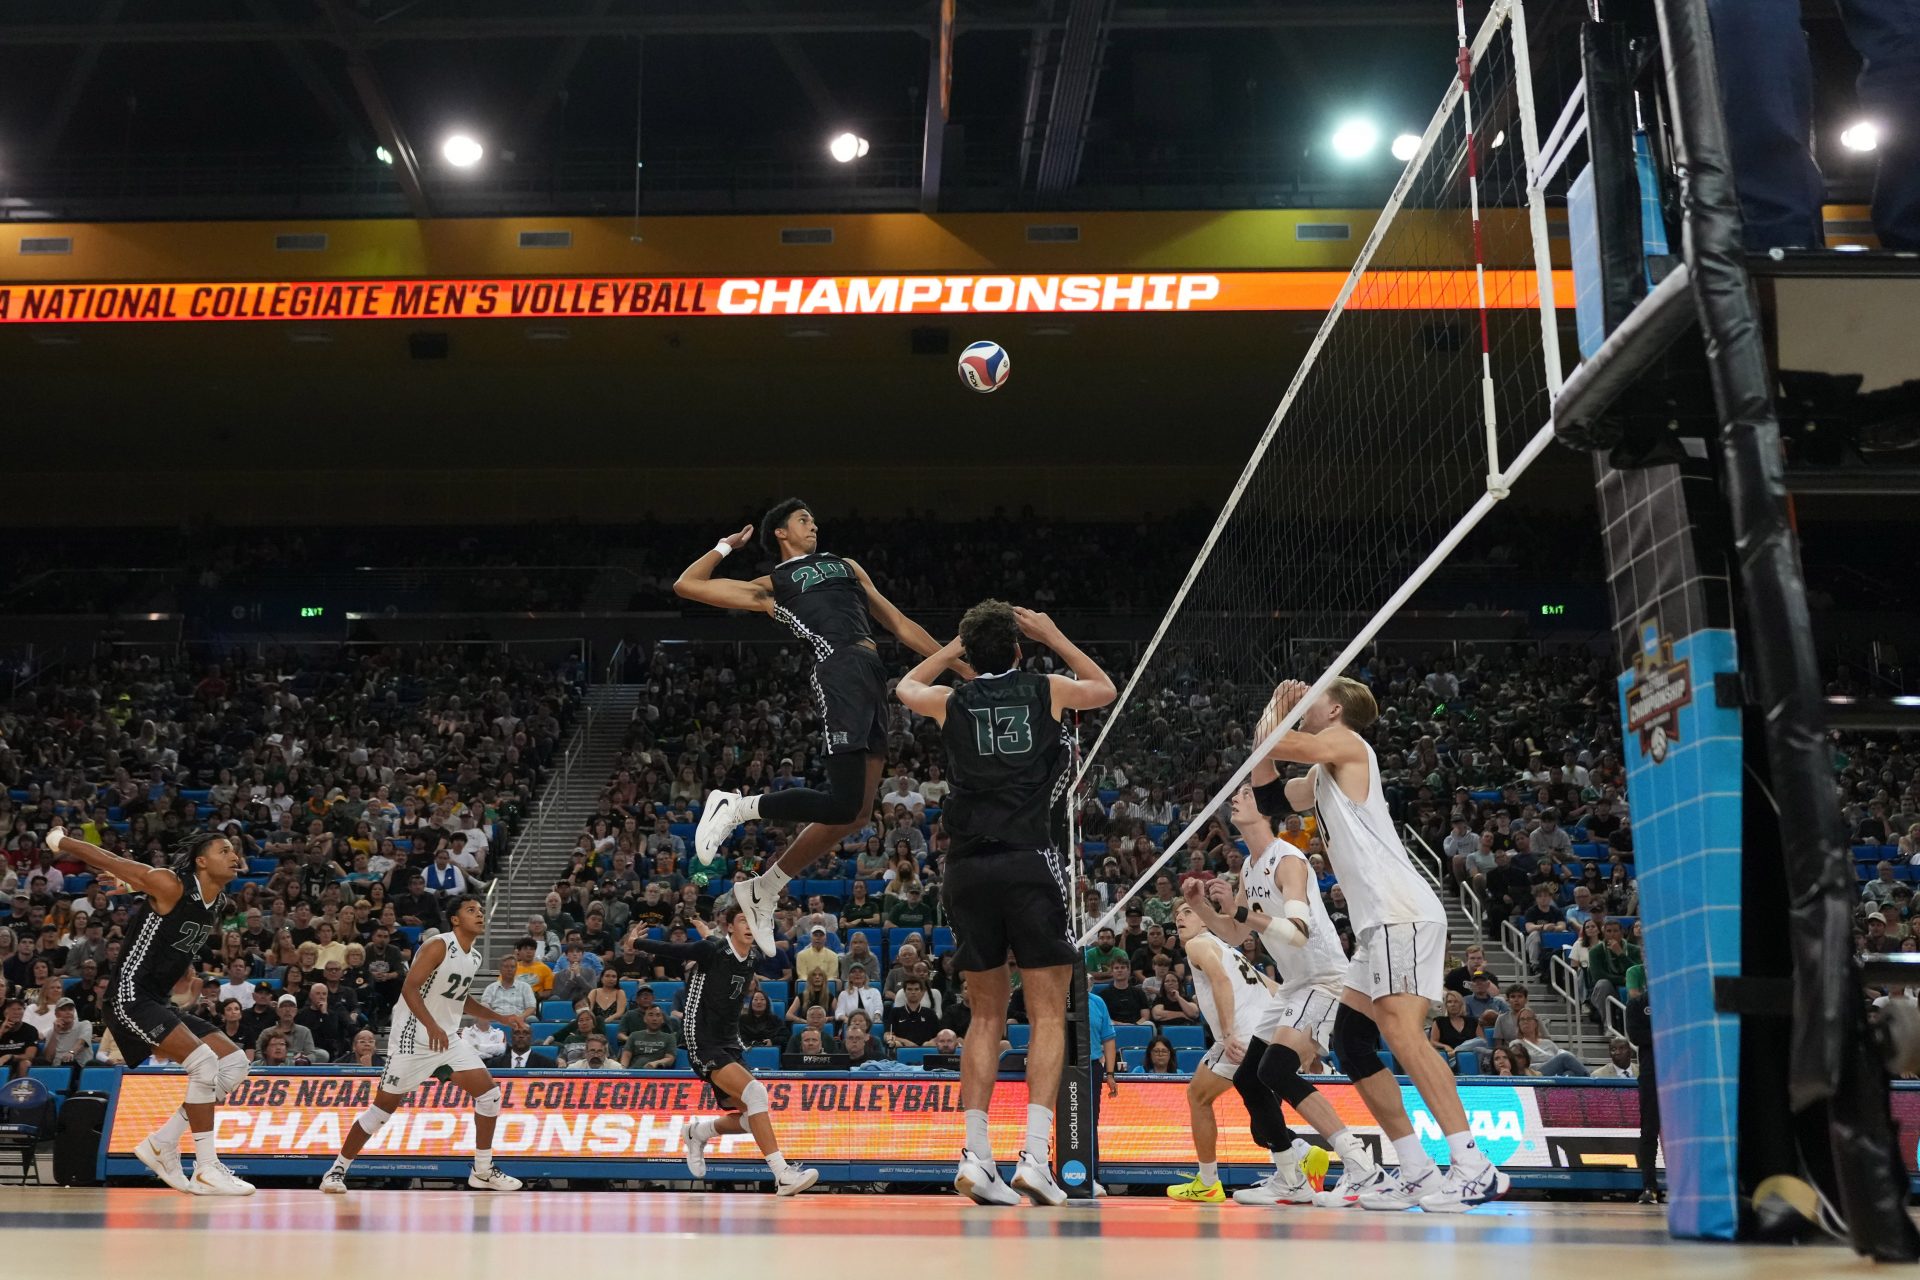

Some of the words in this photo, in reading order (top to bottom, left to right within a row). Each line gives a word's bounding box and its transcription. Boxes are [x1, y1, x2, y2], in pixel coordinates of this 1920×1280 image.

[21, 287, 177, 319] NATIONAL
[188, 285, 384, 318] COLLEGIATE
[390, 283, 498, 316] MEN'S
[510, 281, 706, 315] VOLLEYBALL
[716, 274, 1221, 315] CHAMPIONSHIP
[791, 561, 848, 593] 20
[300, 607, 324, 617] EXIT
[1541, 604, 1565, 615] EXIT
[967, 704, 1033, 756] 13
[440, 973, 473, 1002] 22
[729, 974, 746, 1000] 7
[215, 1079, 291, 1107] 026
[295, 1080, 371, 1107] NCAA
[399, 1080, 515, 1108] ATIONL
[525, 1081, 692, 1110] COLLEGIATE
[697, 1083, 792, 1112] M'S
[1069, 1081, 1078, 1112] sports
[1069, 1112, 1078, 1150] imports
[1412, 1110, 1523, 1142] NAA
